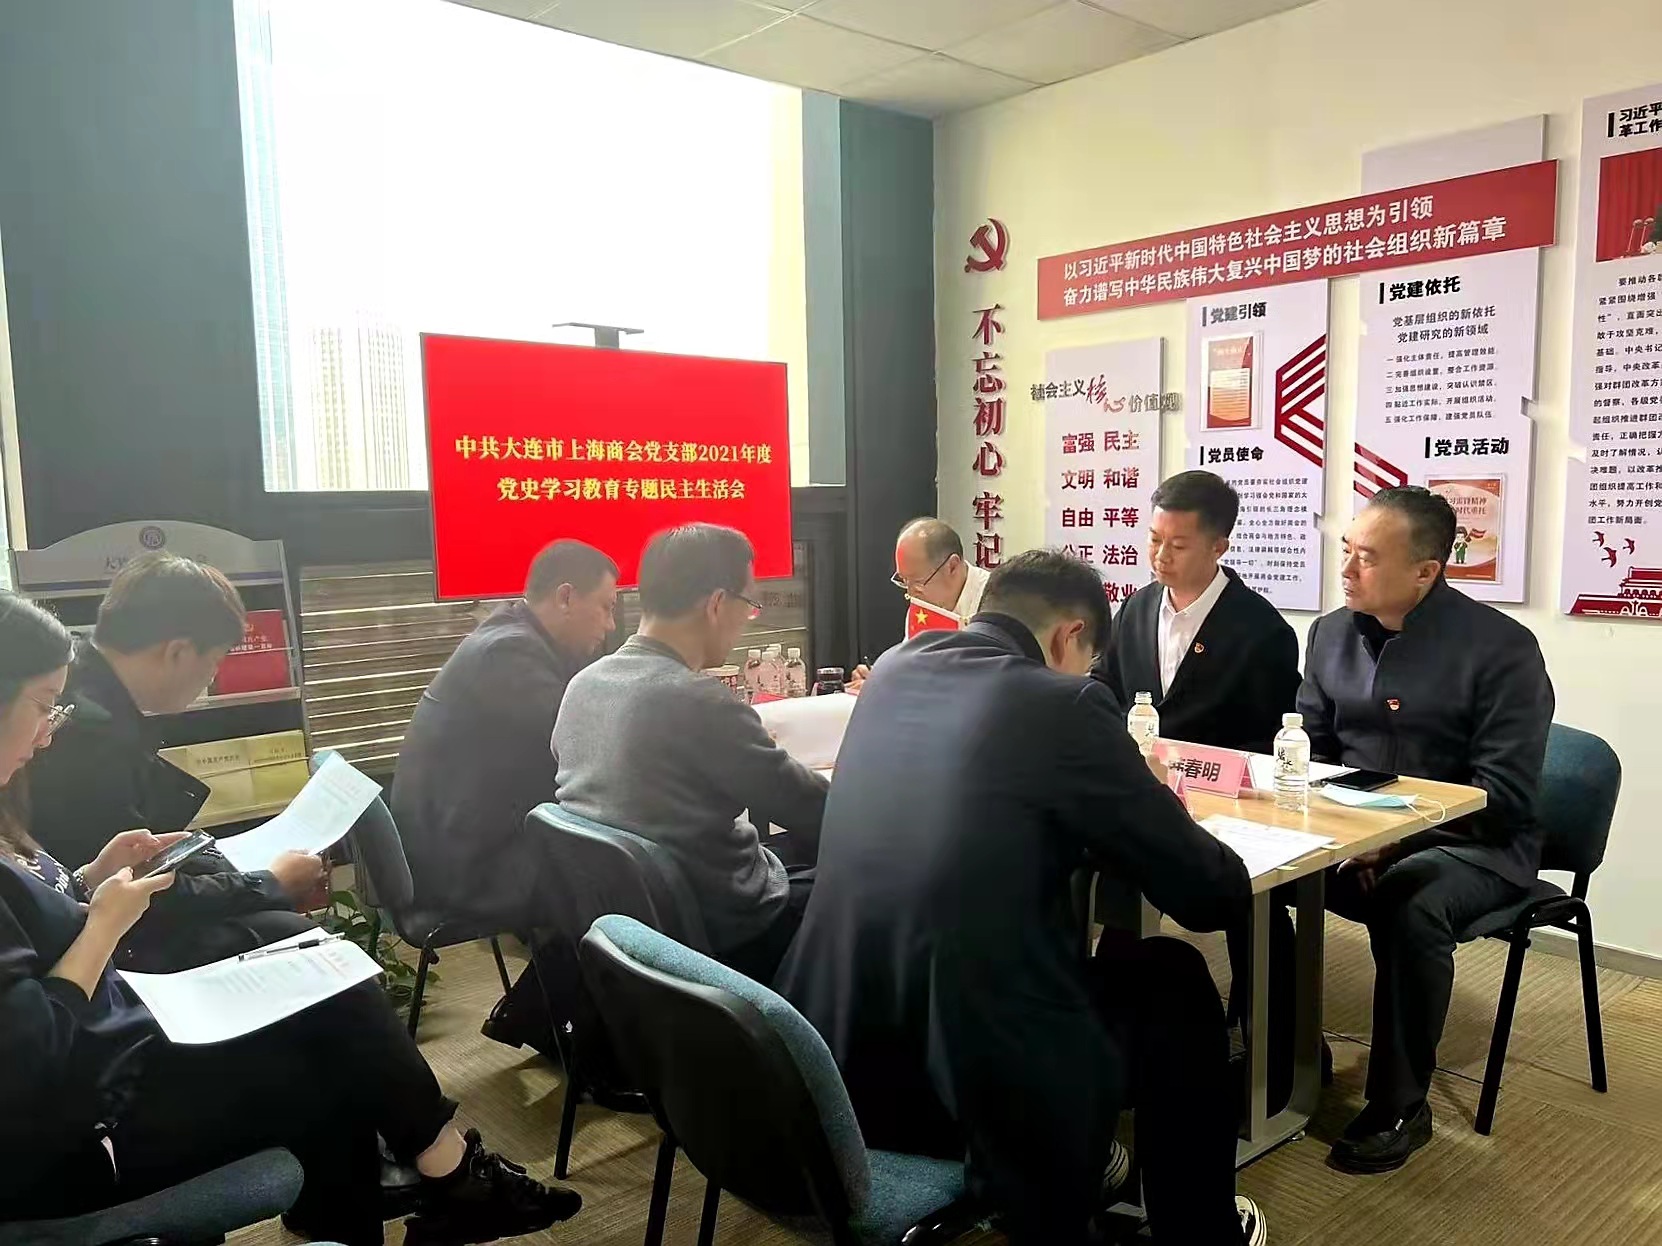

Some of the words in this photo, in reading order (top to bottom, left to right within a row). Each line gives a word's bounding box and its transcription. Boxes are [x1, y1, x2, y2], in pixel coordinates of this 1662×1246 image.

[1619, 101, 1662, 122] 习近平
[1619, 118, 1662, 138] 革工作
[1064, 195, 1433, 281] 以习近平新时代中国特色社会主义思想为引领
[1063, 215, 1507, 306] 奋力谱写中华民族伟大复兴中国梦的社会组织新篇章
[1389, 276, 1461, 301] 党建依托
[1210, 302, 1267, 324] 党建引领
[1392, 305, 1496, 328] 党基层组织的新依托
[1397, 323, 1489, 343] 党建研究的新领域
[1594, 379, 1662, 391] 强对群团改革方
[1593, 396, 1662, 407] 的督察，各级党
[455, 434, 772, 465] 中共大连市上海商会党支部2021年度
[1062, 432, 1095, 454] 富强
[1104, 430, 1140, 451] 民主
[1434, 437, 1510, 457] 党员活动
[1208, 446, 1264, 463] 党员使命
[1061, 469, 1095, 490] 文明
[1103, 466, 1140, 489] 和谐
[497, 477, 745, 501] 党史学习教育专题民主生活会
[1061, 508, 1094, 528] 自由
[1103, 507, 1139, 528] 平等
[1102, 544, 1139, 565] 法治
